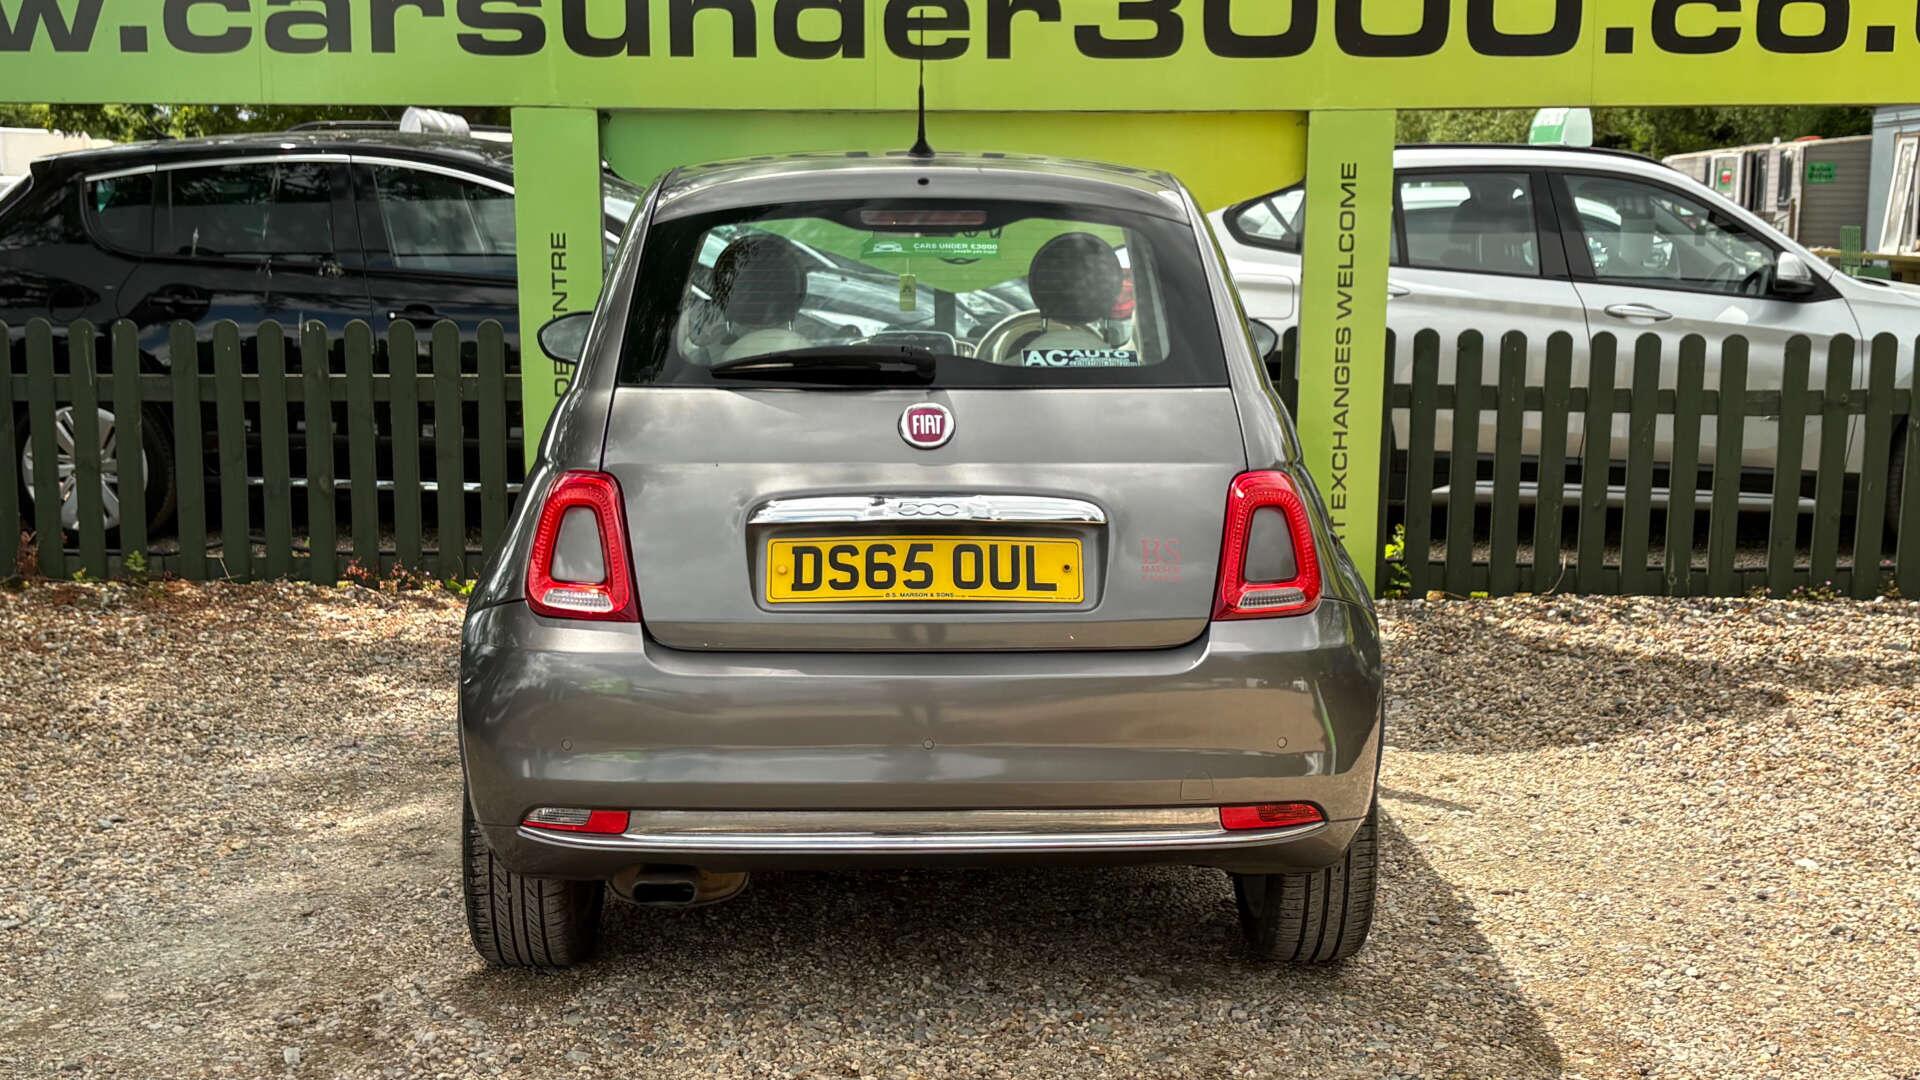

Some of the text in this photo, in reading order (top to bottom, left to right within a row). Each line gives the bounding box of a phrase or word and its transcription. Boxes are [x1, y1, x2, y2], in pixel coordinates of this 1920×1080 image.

[0, 0, 1920, 58] w.carsunder3000.co.
[913, 242, 937, 250] CARS
[938, 242, 969, 250] UNDER
[1336, 162, 1357, 320] WELCOME
[550, 231, 568, 323] NTRE
[1025, 349, 1069, 367] AC
[1069, 349, 1130, 358] AUTO
[912, 414, 943, 435] FIAT
[1331, 326, 1351, 510] EXCHANGES
[898, 502, 960, 516] 500
[791, 543, 1058, 593] DS65 OUL
